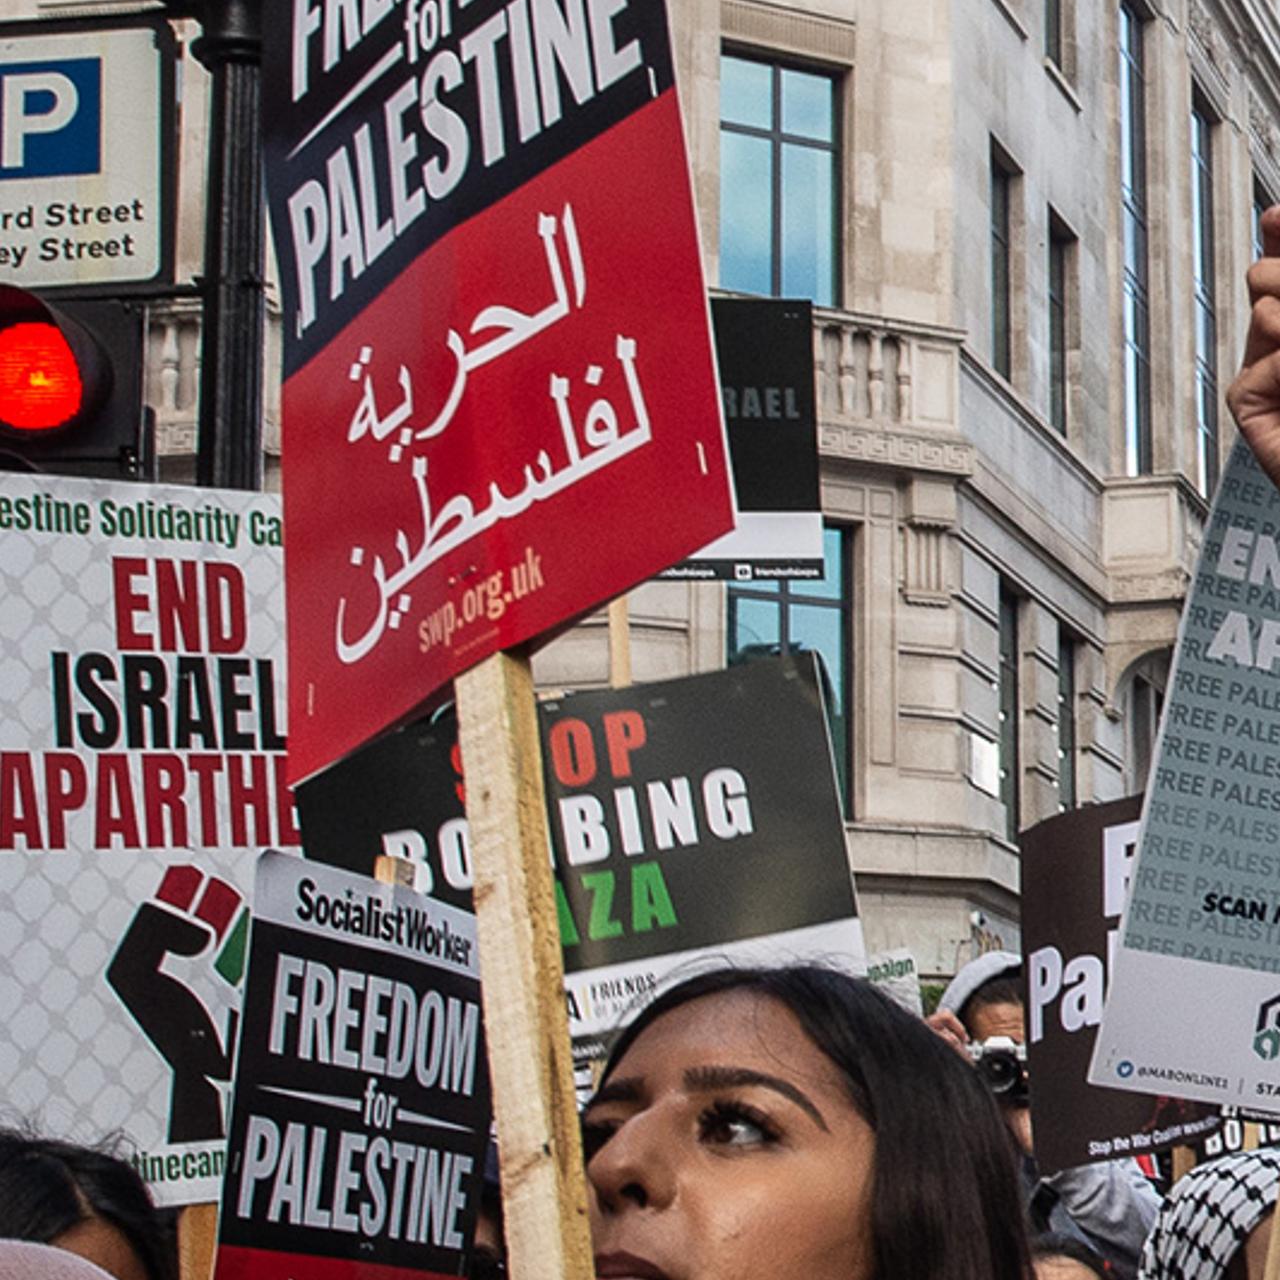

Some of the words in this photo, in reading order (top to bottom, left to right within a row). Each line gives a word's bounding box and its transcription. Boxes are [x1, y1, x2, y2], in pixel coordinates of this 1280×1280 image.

[2, 71, 80, 168] P
[39, 234, 135, 262] Street
[45, 199, 144, 227] Street
[347, 203, 587, 463] الحرية
[100, 498, 241, 549] Solidarity
[335, 334, 652, 664] لفلسطين
[112, 555, 248, 655] END
[418, 546, 546, 655] swp.org.uk
[51, 650, 288, 752] ISRAEL
[382, 766, 754, 896] BOBING
[1202, 892, 1268, 922] SCAN
[268, 952, 479, 1098] FREEDOM
[363, 1078, 397, 1131] for
[236, 1113, 474, 1251] PALESTINE
